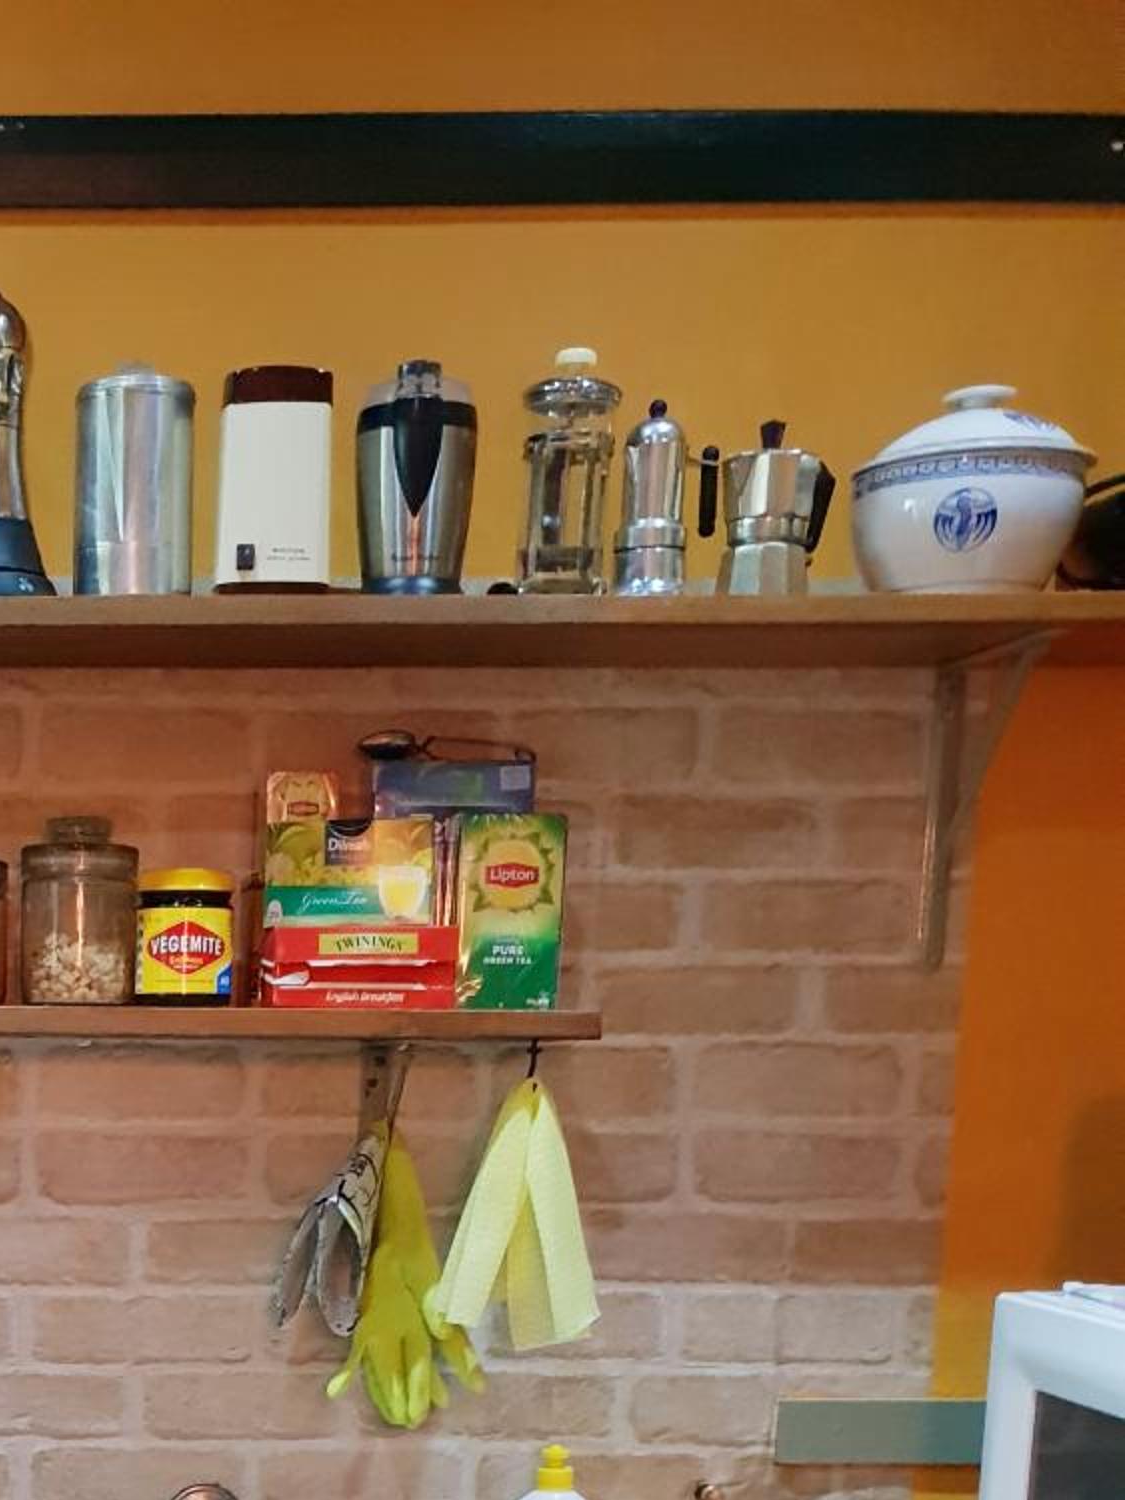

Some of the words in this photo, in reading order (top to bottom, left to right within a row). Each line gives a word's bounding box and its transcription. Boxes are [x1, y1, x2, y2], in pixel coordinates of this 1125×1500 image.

[490, 866, 535, 884] Lipton
[296, 891, 339, 916] Green
[151, 935, 222, 956] VEGEMITE
[335, 934, 403, 952] TWININGS
